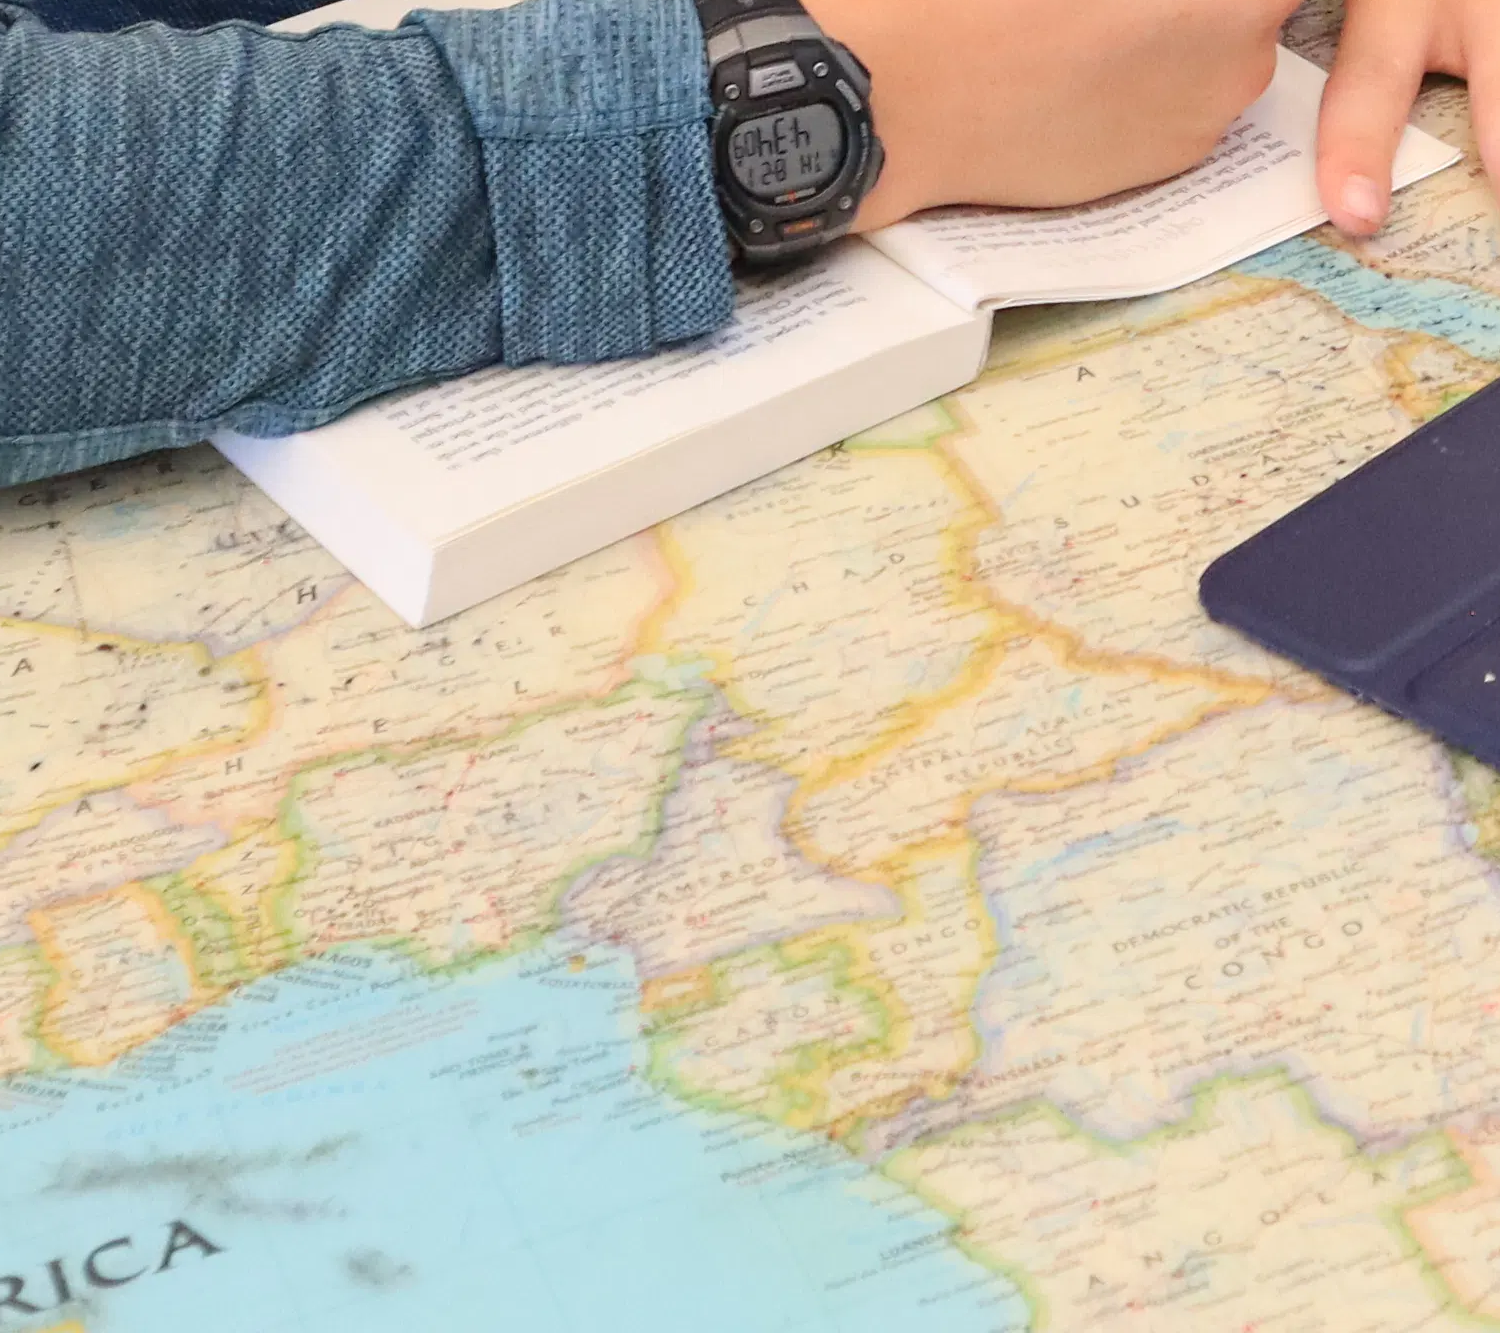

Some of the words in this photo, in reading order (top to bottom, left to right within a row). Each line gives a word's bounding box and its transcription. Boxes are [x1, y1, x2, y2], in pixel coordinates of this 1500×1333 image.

[1112, 898, 1254, 954] DEMOCRATIC
[1261, 861, 1364, 911] REPUBLIC
[869, 918, 982, 964] CONGO
[1214, 931, 1245, 951] OF
[1252, 916, 1293, 941] THE
